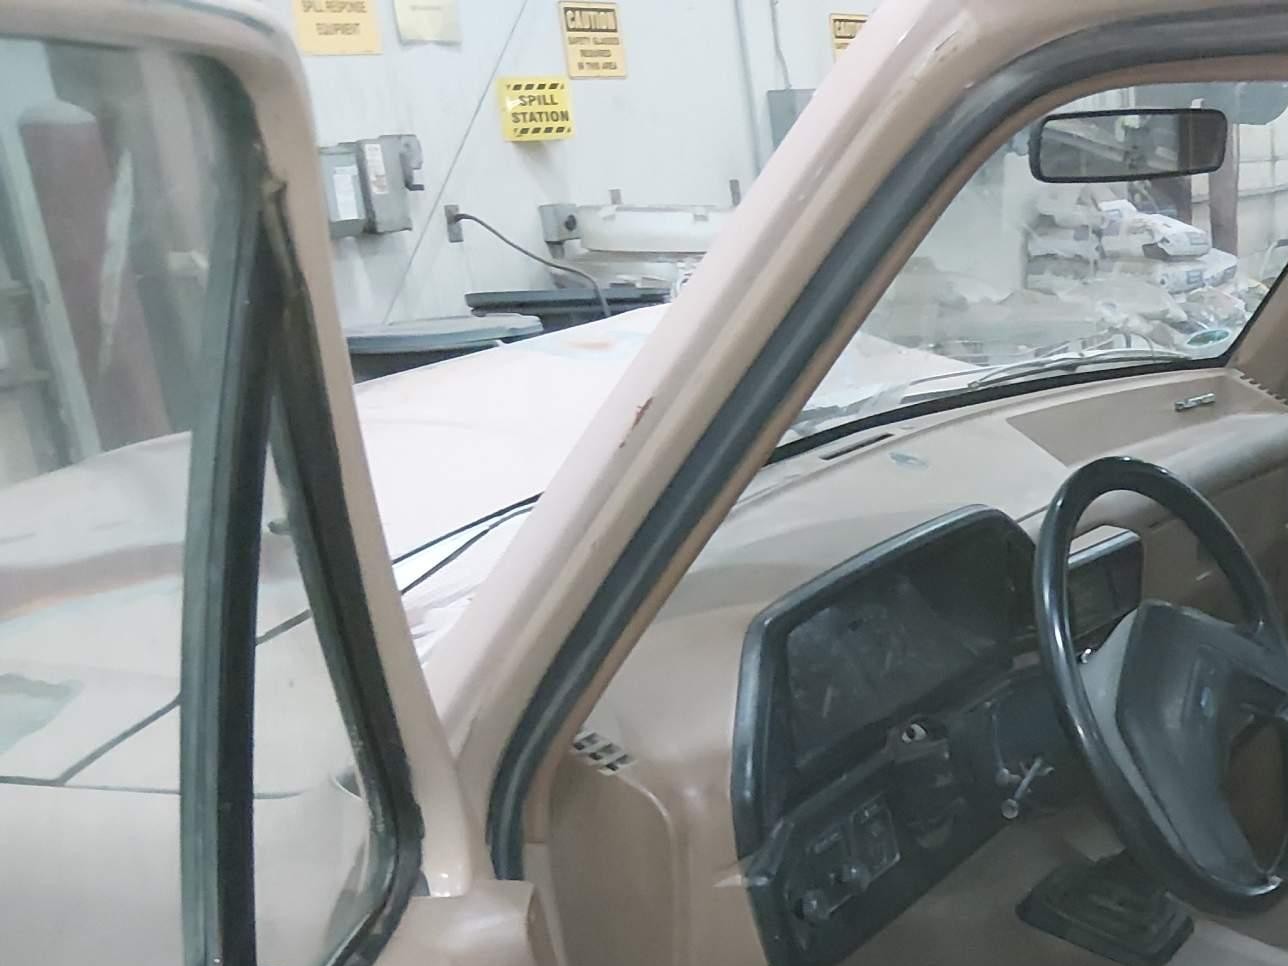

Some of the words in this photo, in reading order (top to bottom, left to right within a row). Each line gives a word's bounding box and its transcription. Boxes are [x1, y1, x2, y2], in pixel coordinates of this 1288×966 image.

[565, 9, 616, 30] CAUTION
[518, 94, 559, 107] SPILL
[511, 110, 569, 124] STATION
